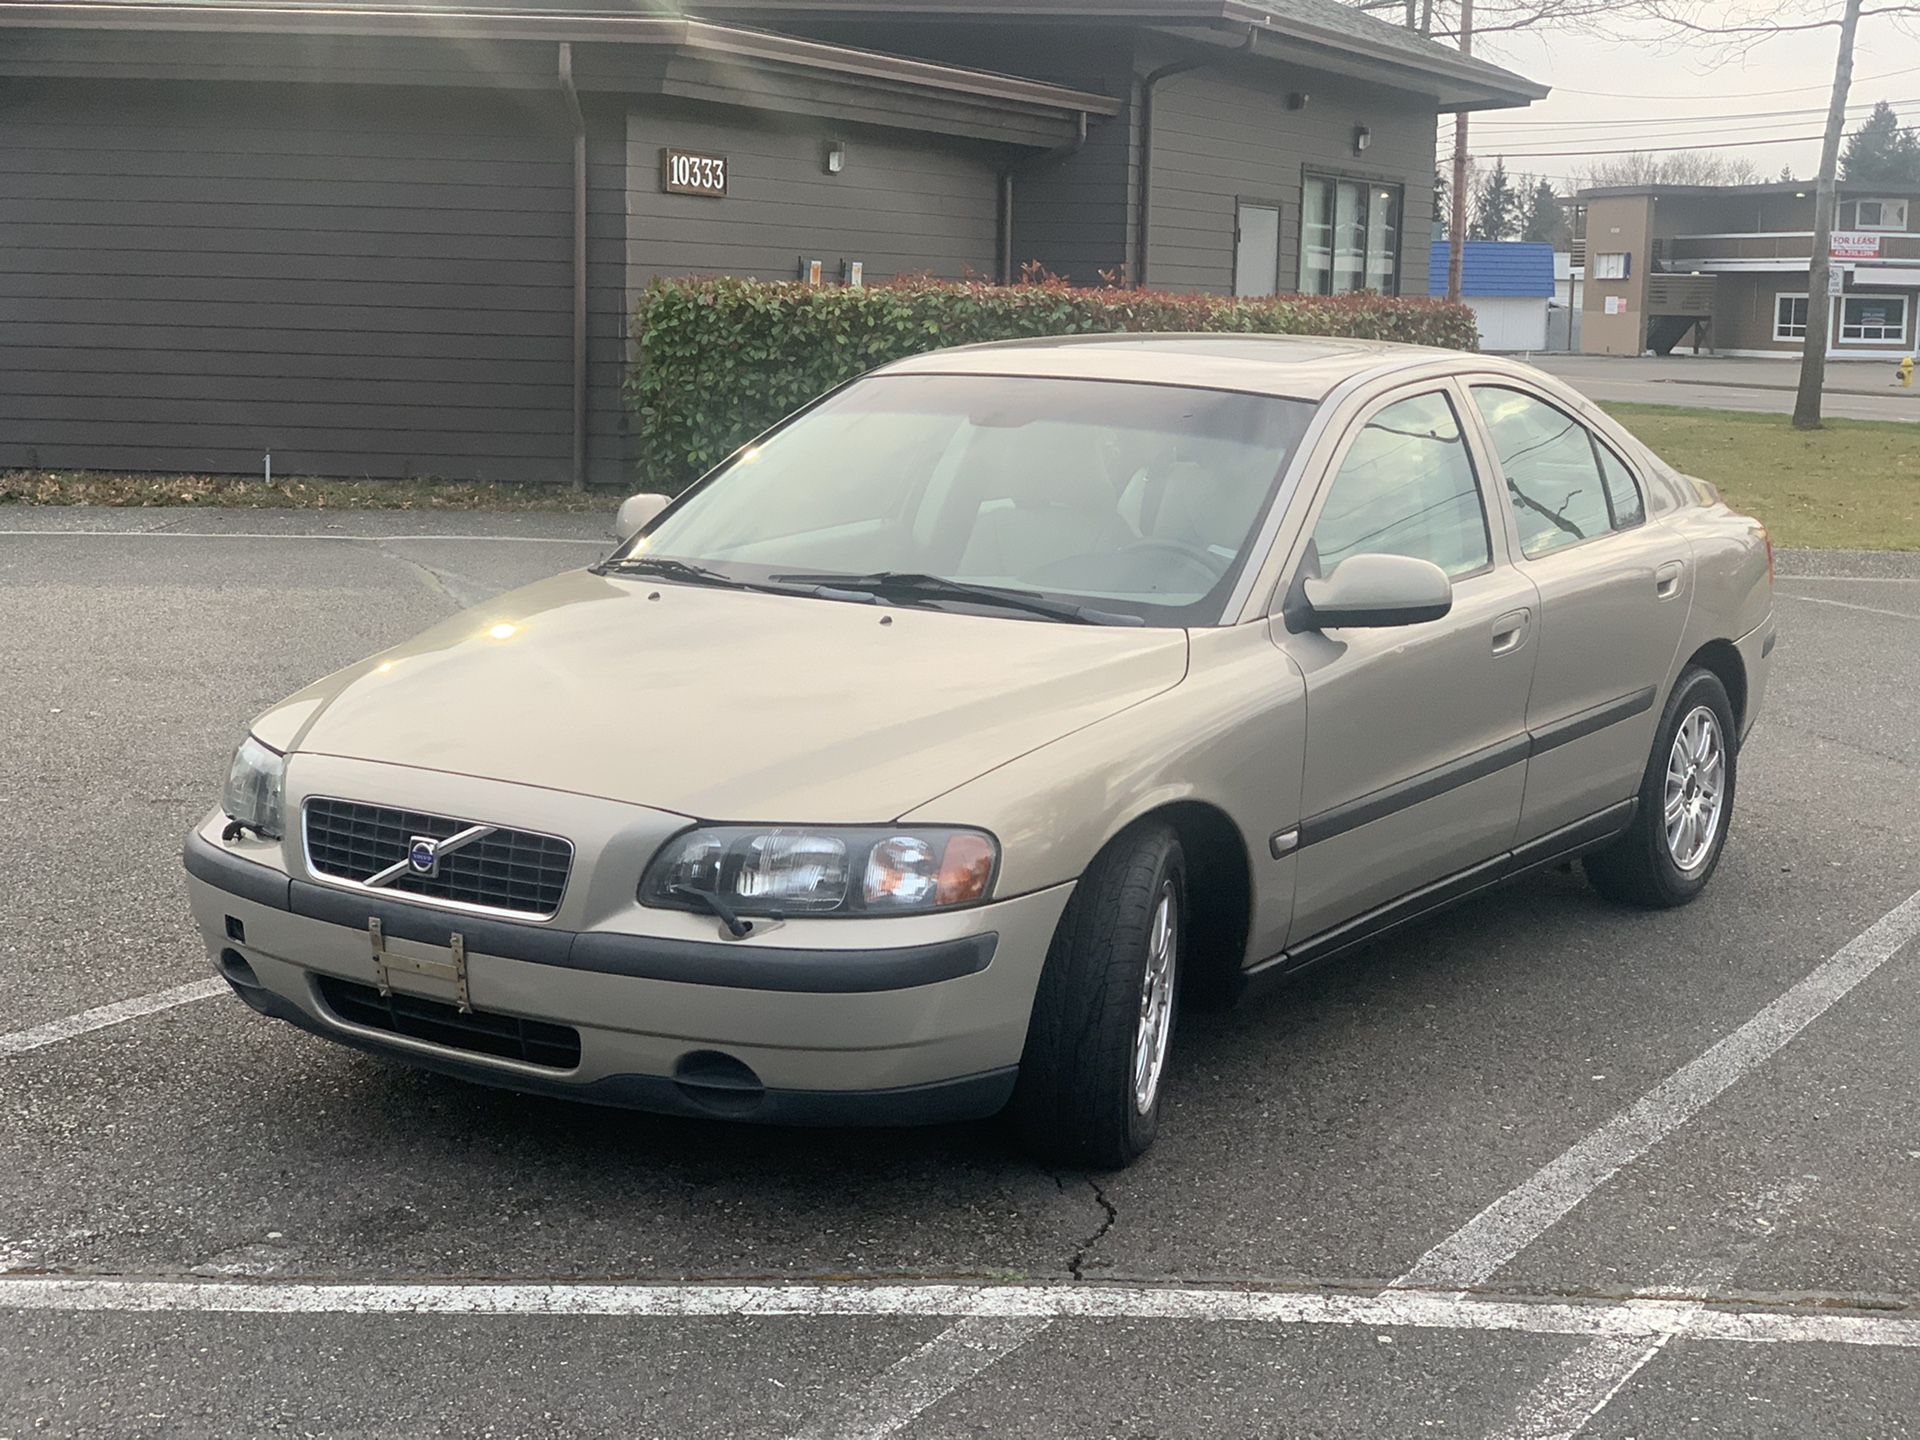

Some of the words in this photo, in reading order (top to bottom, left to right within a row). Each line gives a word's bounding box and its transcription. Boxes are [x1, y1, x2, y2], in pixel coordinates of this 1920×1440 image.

[671, 155, 724, 189] 10333
[1833, 236, 1850, 245] FOR
[1852, 236, 1877, 245] LEASE
[412, 853, 433, 861] VOLVO
